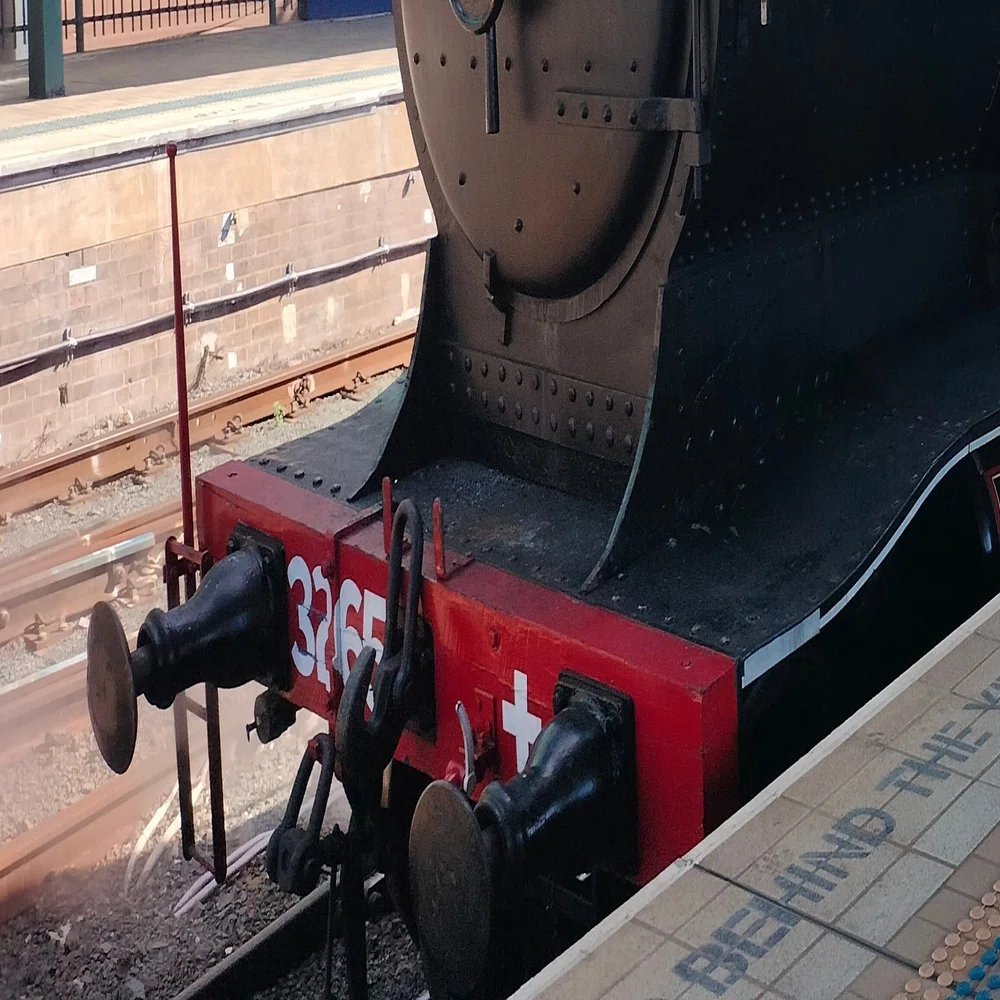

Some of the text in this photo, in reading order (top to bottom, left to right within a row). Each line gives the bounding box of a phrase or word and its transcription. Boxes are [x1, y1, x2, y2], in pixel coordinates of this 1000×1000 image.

[286, 555, 387, 713] 3265
[673, 806, 897, 996] BEHIND
[876, 721, 994, 798] THE
